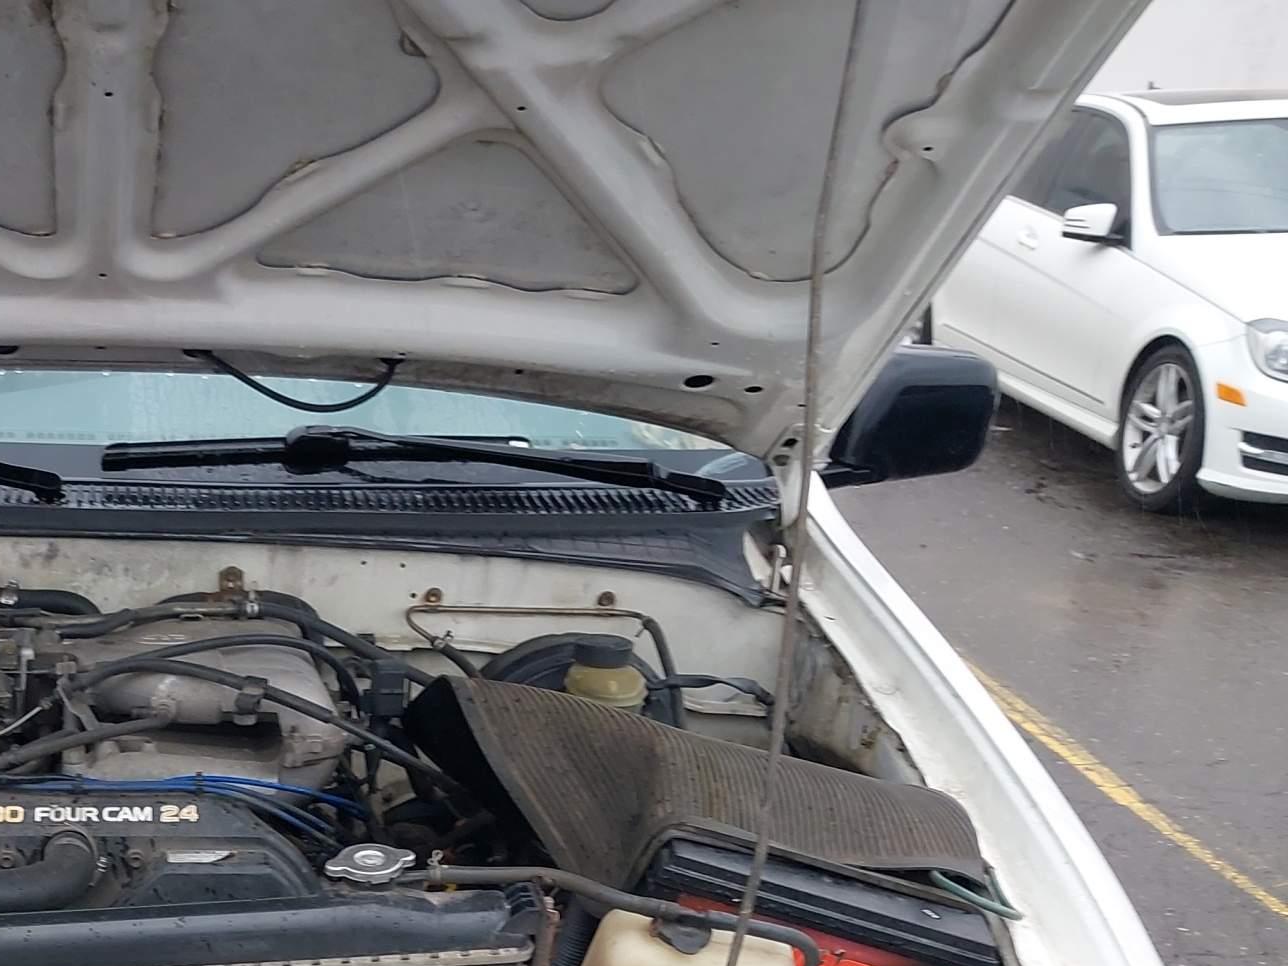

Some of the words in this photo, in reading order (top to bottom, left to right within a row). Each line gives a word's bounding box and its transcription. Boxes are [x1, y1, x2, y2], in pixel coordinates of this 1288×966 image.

[33, 805, 100, 823] FOUR
[102, 806, 153, 823] CAM
[159, 804, 200, 823] 24
